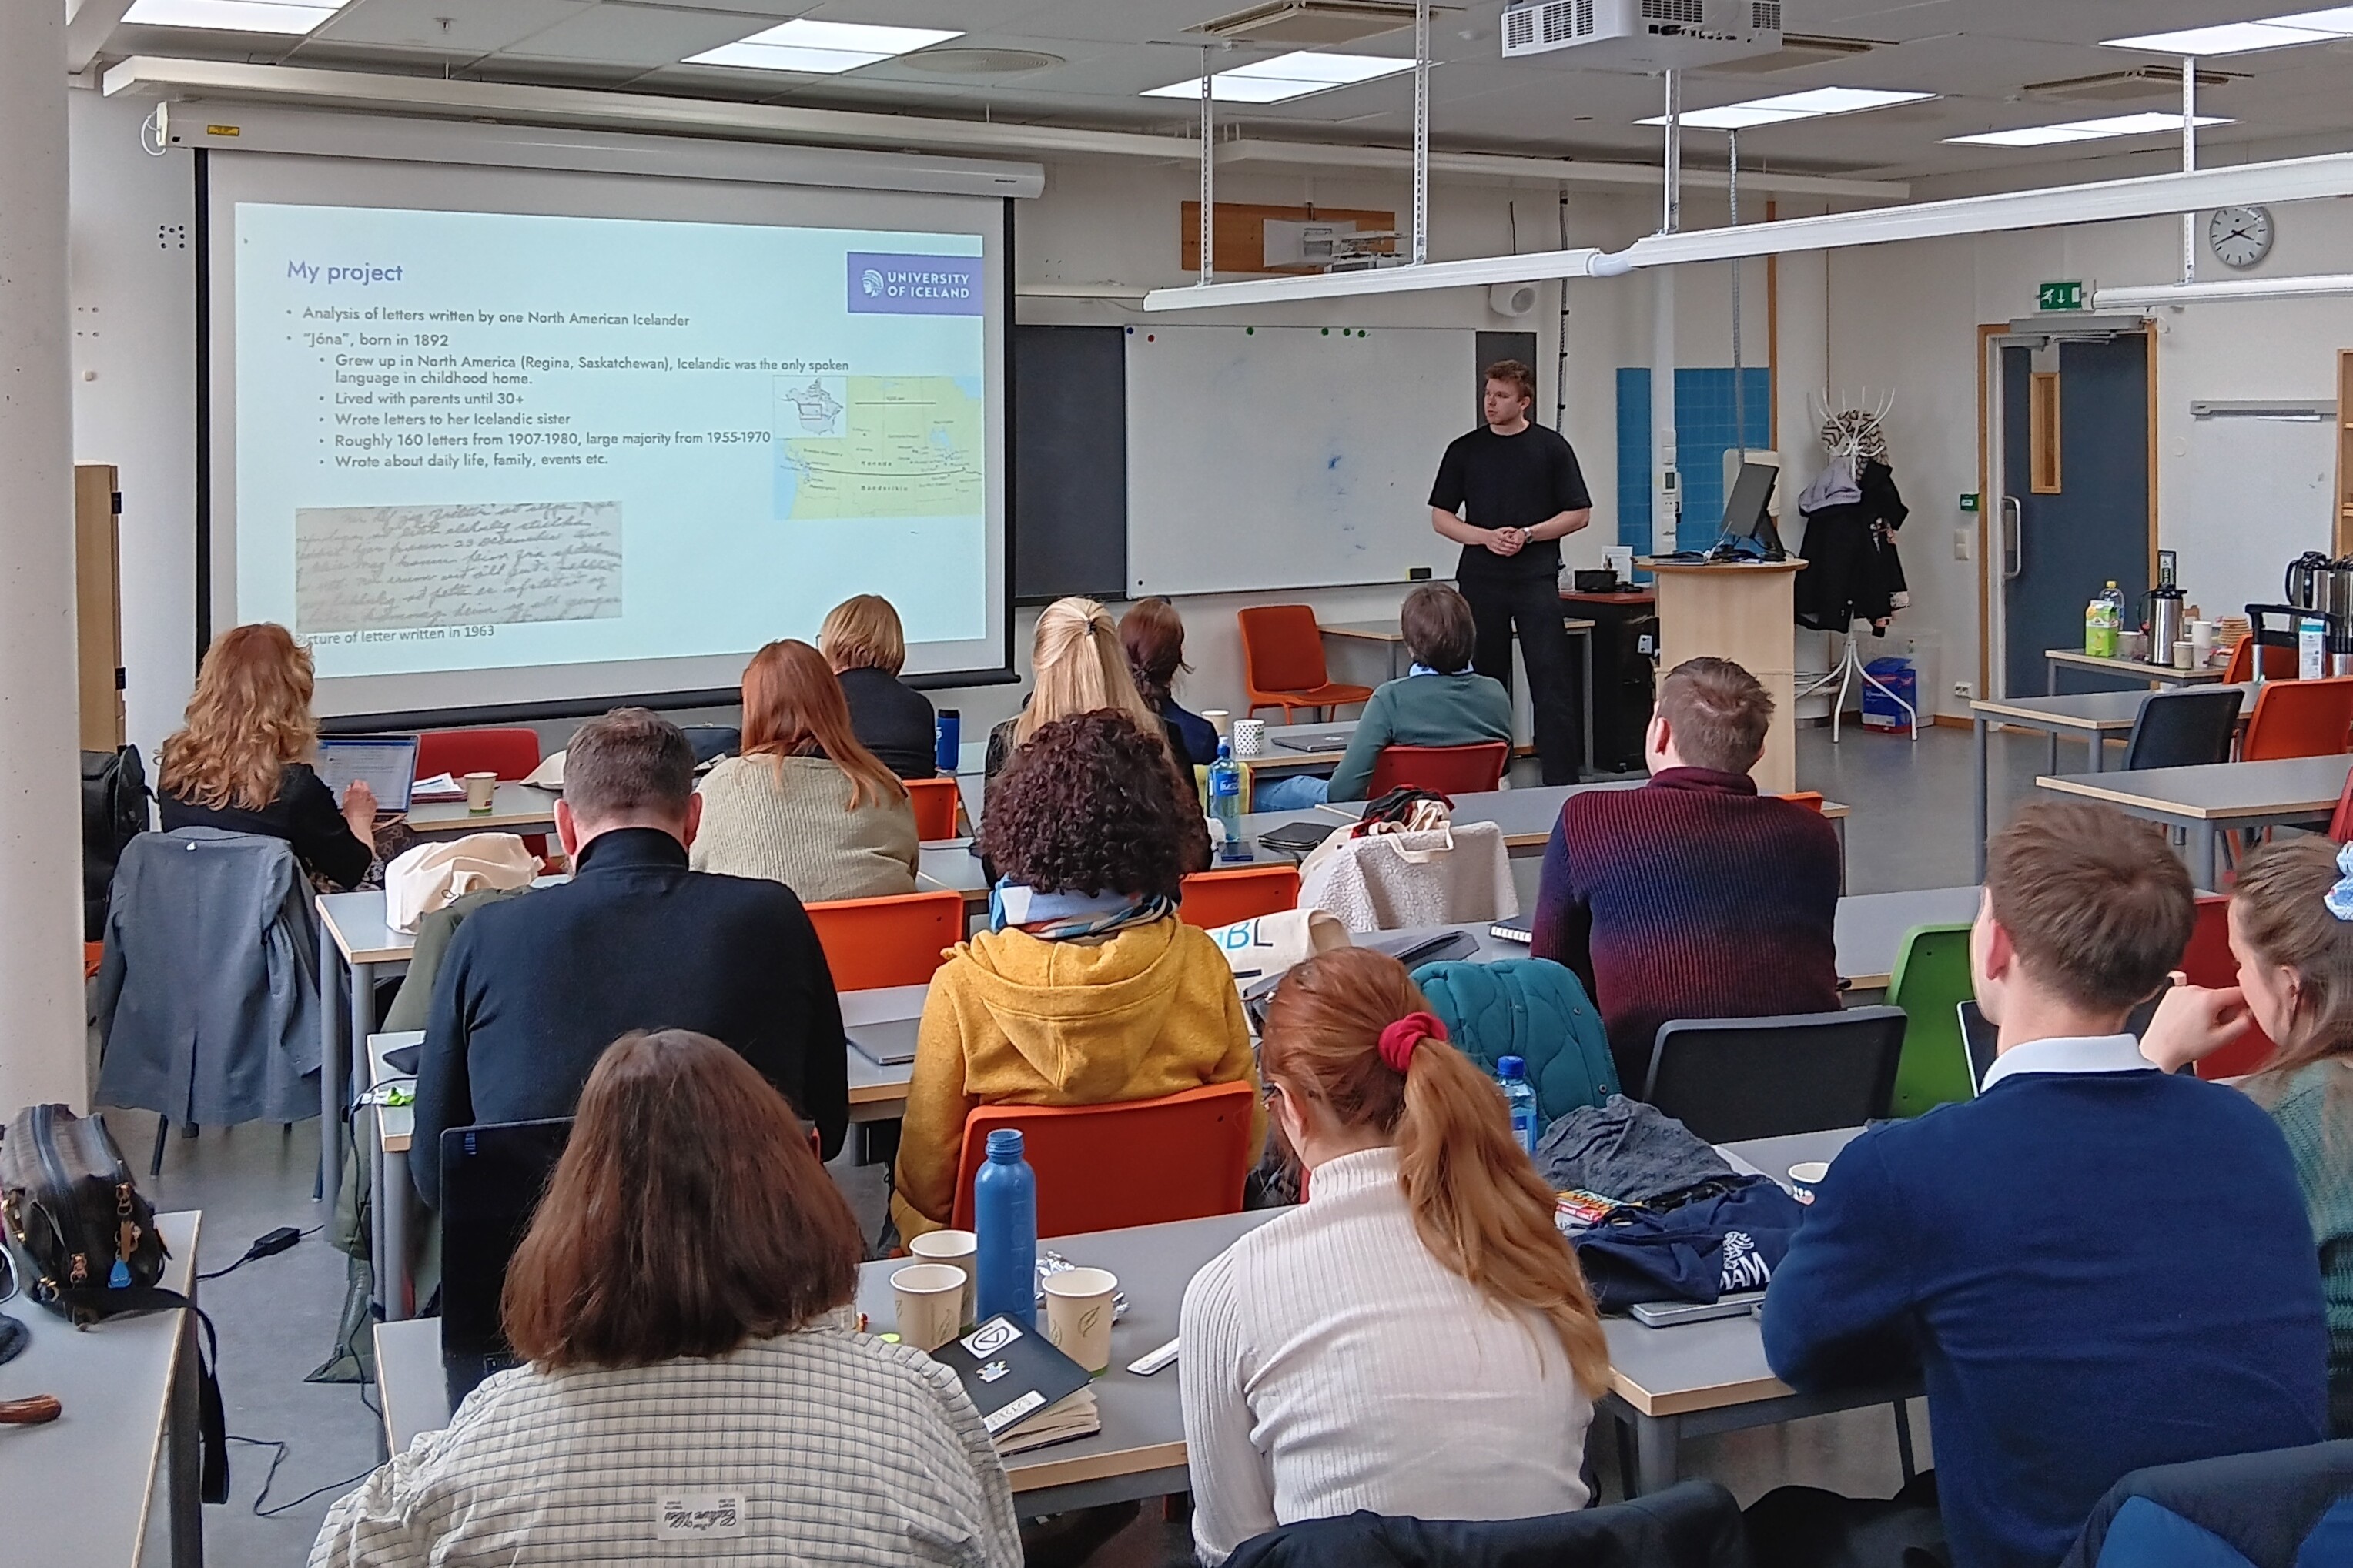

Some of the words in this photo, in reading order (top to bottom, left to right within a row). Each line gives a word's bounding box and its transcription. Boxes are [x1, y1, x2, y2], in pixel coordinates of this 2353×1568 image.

[287, 260, 320, 283] My
[327, 262, 403, 286] project
[887, 271, 969, 285] UNIVERSITY
[887, 286, 905, 297] OF
[911, 286, 969, 299] ICELAND
[303, 306, 360, 323] Analysis
[365, 307, 378, 320] of
[383, 307, 425, 321] letters
[430, 309, 474, 323] written
[479, 309, 494, 326] by
[500, 313, 524, 323] one
[528, 311, 564, 324] North
[569, 312, 629, 325] American
[633, 313, 690, 326] Icelander
[360, 333, 392, 346] born
[397, 333, 409, 346] in
[414, 334, 449, 346] 1892
[336, 353, 374, 366] Grew
[379, 358, 396, 369] up
[400, 355, 413, 366] in
[418, 354, 457, 367] North
[461, 356, 516, 368] America
[521, 354, 574, 371] (Regina,
[578, 356, 673, 372] Saskatchewan),
[678, 357, 731, 369] Icelandic
[760, 358, 778, 369] the
[781, 358, 805, 373] only
[809, 358, 849, 373] spoken
[336, 370, 400, 386] language
[403, 371, 416, 383] in
[421, 370, 487, 384] childhood
[493, 371, 533, 384] home.
[336, 391, 373, 404] Lived
[378, 391, 406, 404] with
[410, 394, 460, 408] parents
[464, 391, 493, 404] until
[497, 393, 524, 405] 30+
[335, 413, 380, 425] Wrote
[384, 412, 426, 425] letters
[430, 414, 443, 425] to
[447, 412, 470, 425] her
[474, 412, 533, 425] Icelandic
[537, 413, 571, 425] sister
[335, 433, 393, 450] Roughly
[397, 433, 423, 446] 160
[427, 433, 468, 446] letters
[473, 433, 503, 446] from
[508, 433, 581, 446] 1907-1980,
[587, 432, 618, 447] large
[622, 432, 671, 447] majority
[675, 431, 703, 444] from
[708, 431, 771, 443] 1955-1970
[335, 456, 380, 468] Wrote
[384, 454, 423, 467] about
[427, 453, 460, 470] daily
[464, 453, 488, 468] life,
[494, 453, 536, 468] family,
[541, 453, 581, 465] events
[586, 453, 608, 465] etc.
[344, 631, 358, 644] of
[361, 630, 396, 643] letter
[400, 628, 445, 641] written
[449, 626, 460, 638] in
[464, 625, 494, 638] 1963
